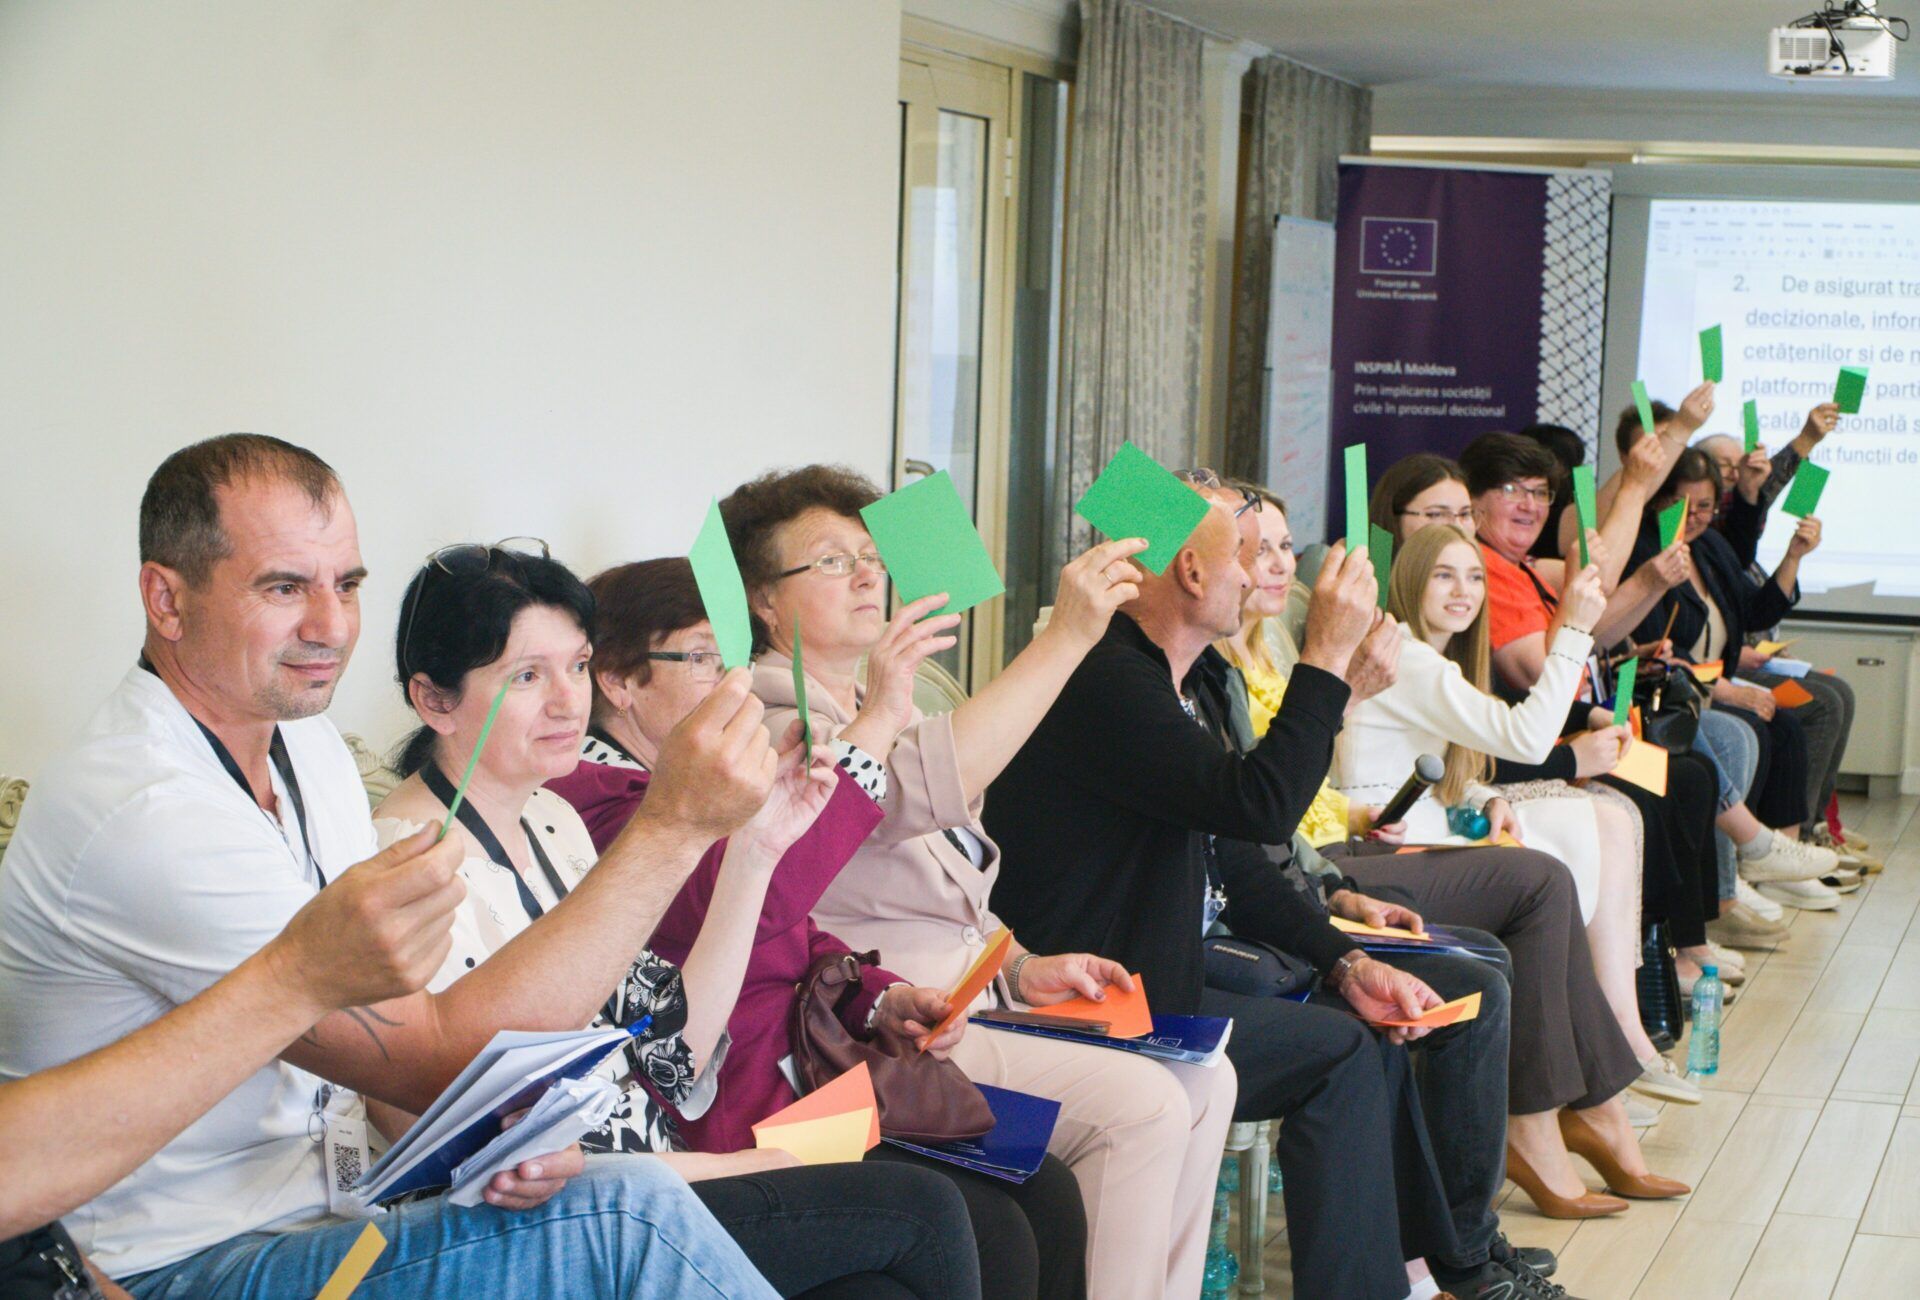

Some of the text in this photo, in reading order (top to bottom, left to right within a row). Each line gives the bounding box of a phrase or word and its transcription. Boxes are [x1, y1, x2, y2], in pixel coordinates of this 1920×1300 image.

[1733, 275, 1750, 292] 2.
[1782, 275, 1808, 292] De
[1814, 276, 1894, 298] asigurat
[1745, 307, 1865, 329] decizionale,
[1743, 343, 1852, 365] cetățenilor
[1880, 345, 1904, 363] de
[1354, 360, 1457, 376] INSPIRĂ Moldova
[1354, 383, 1377, 396] Prin
[1380, 385, 1438, 399] implicarea
[1353, 402, 1383, 414] civile
[1398, 404, 1447, 417] procesul
[1449, 404, 1506, 418] decizional
[1837, 446, 1891, 465] funcții
[1897, 448, 1918, 464] de
